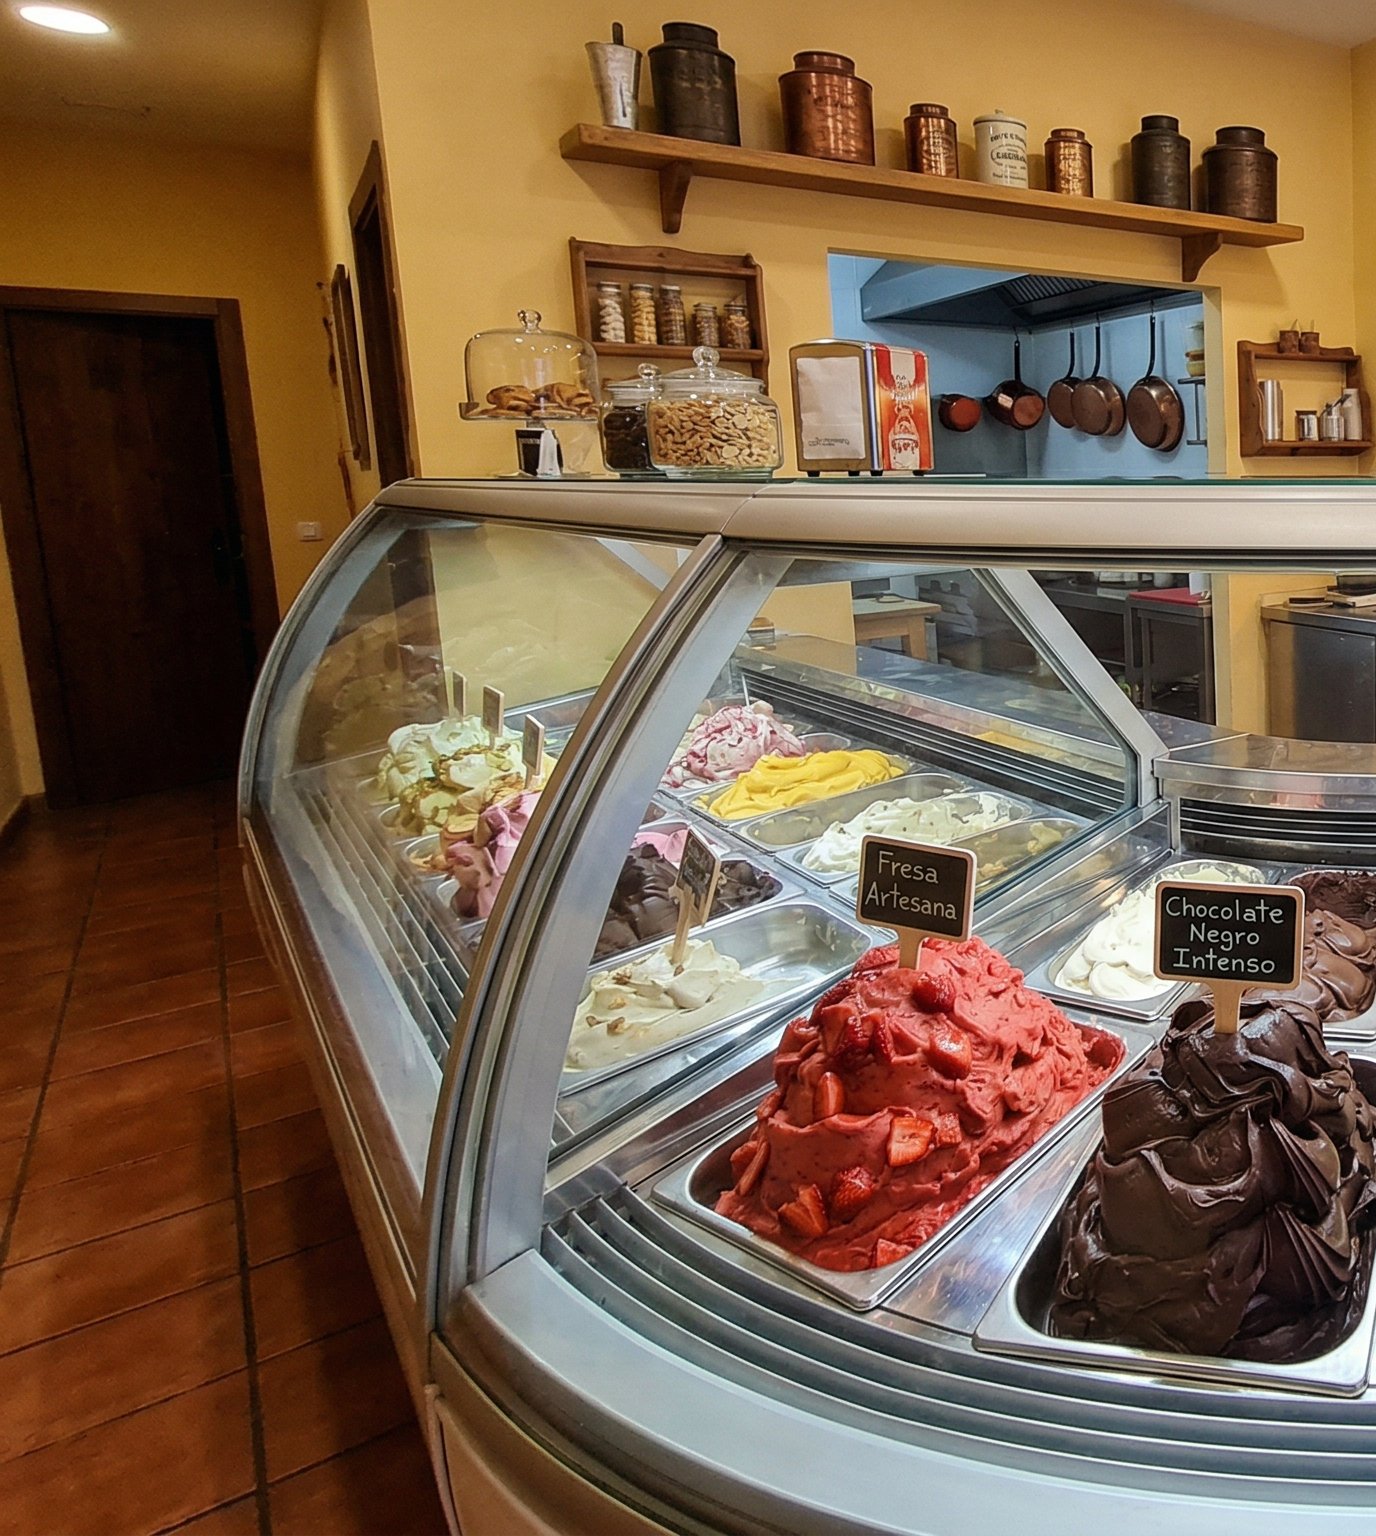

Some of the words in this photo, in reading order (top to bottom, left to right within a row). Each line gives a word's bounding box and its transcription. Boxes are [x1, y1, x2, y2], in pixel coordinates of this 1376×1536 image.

[878, 850, 939, 884] Fresa
[864, 881, 958, 920] Artesana
[1165, 896, 1285, 924] Chocolate
[1190, 922, 1260, 952] Negro
[1172, 947, 1276, 974] Intenso
